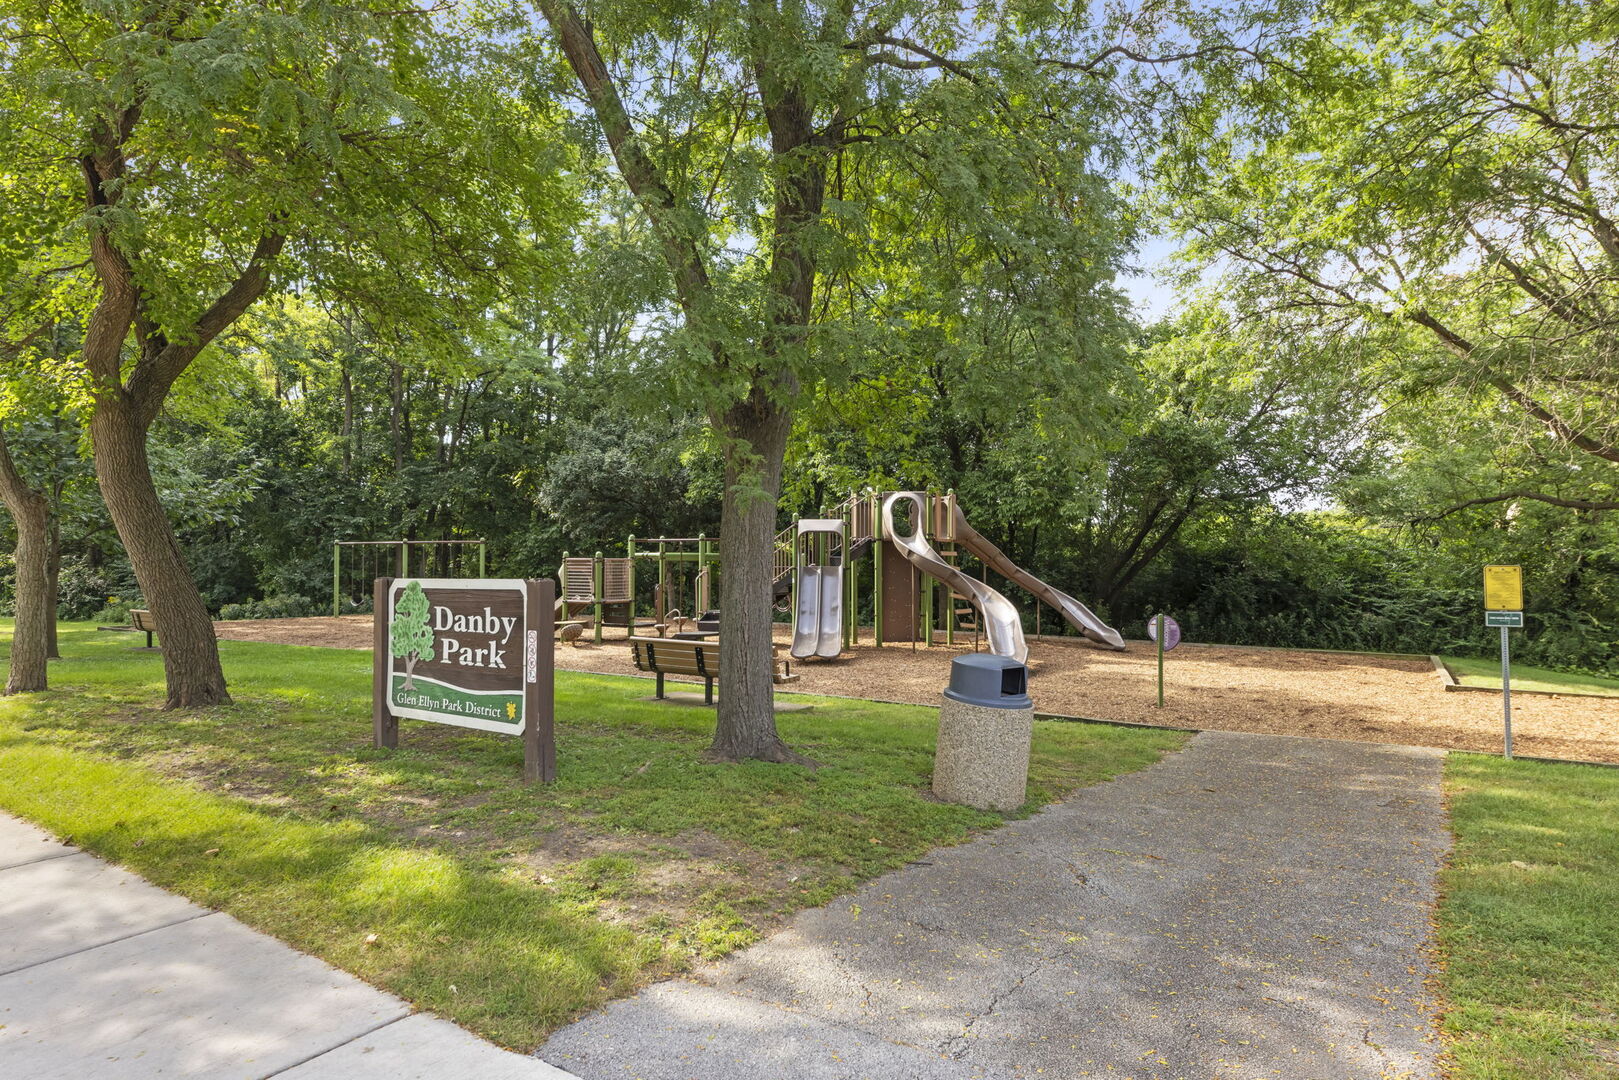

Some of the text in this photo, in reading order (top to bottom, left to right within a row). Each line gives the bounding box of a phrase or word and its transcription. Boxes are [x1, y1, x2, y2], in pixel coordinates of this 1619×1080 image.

[433, 605, 517, 645] Danby
[440, 638, 507, 669] Park
[397, 693, 501, 718] Glen Ellyn Park District
